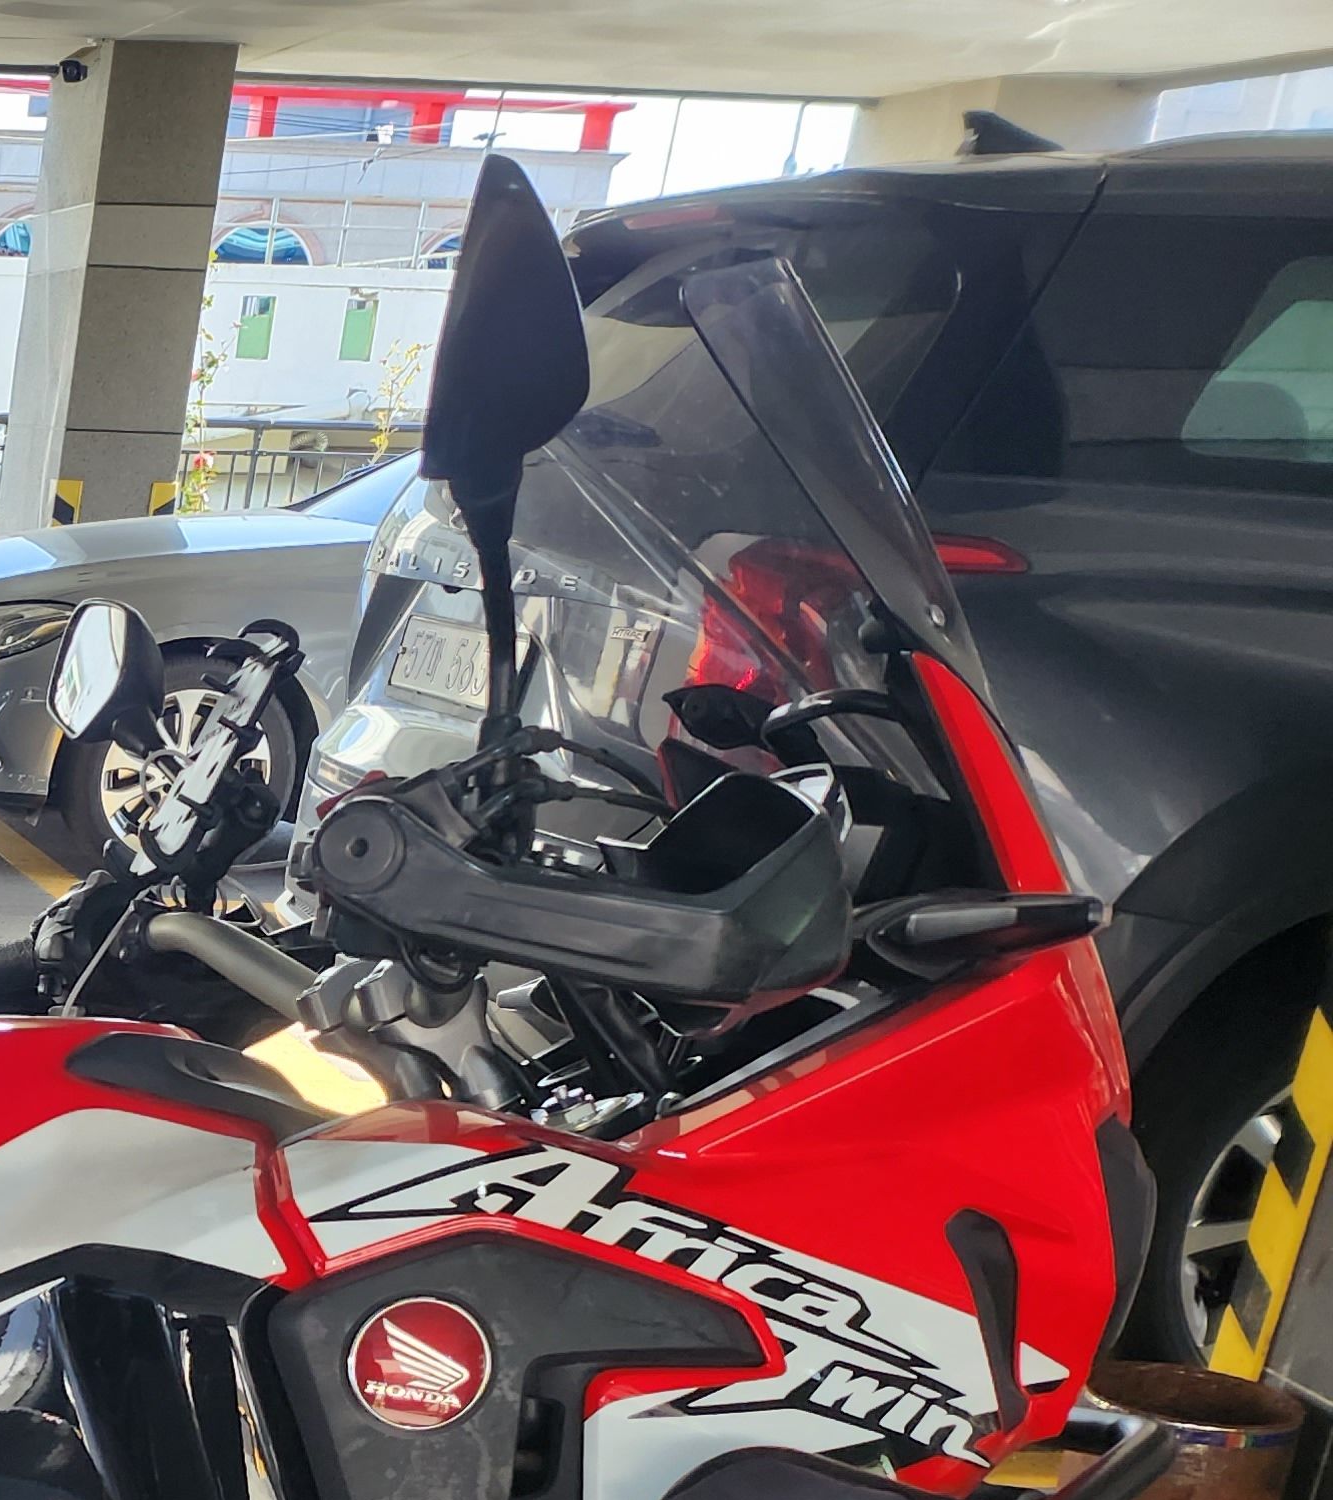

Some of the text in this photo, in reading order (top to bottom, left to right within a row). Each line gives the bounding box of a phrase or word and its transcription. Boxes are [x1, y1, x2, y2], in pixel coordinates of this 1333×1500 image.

[345, 1143, 893, 1357] Africa
[363, 1379, 462, 1409] HONDA
[685, 1326, 993, 1468] Twin
